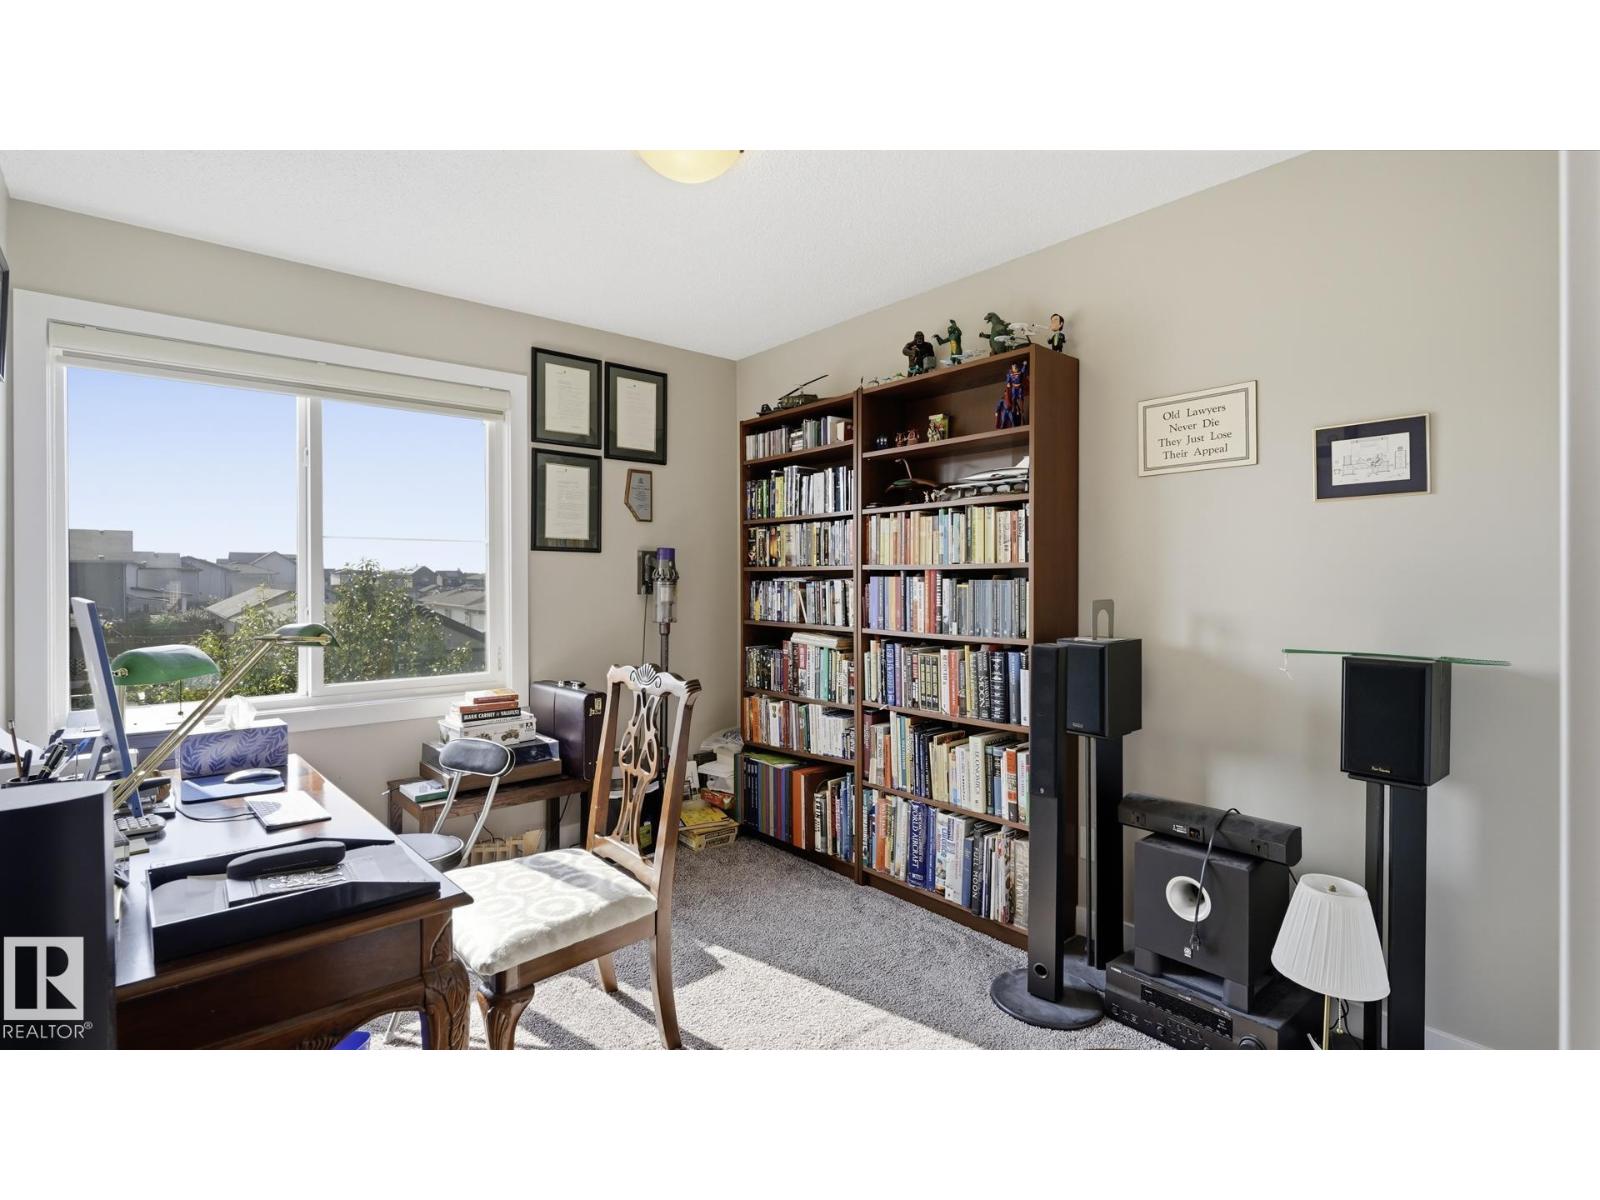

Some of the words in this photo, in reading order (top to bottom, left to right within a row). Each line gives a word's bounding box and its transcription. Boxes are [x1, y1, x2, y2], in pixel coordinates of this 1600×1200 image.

[1162, 409, 1180, 421] Old
[1186, 404, 1227, 418] Lawyers
[1168, 422, 1198, 433] Never
[1202, 418, 1220, 429] Die
[1157, 437, 1183, 448] They
[1186, 434, 1205, 446] Just
[1210, 431, 1233, 441] Lose
[1162, 449, 1189, 460] Their
[1193, 442, 1229, 457] Appeal
[977, 675, 986, 708] MOON
[910, 832, 920, 869] AIRCRAFT
[972, 846, 980, 866] FULL
[971, 870, 980, 899] MOON
